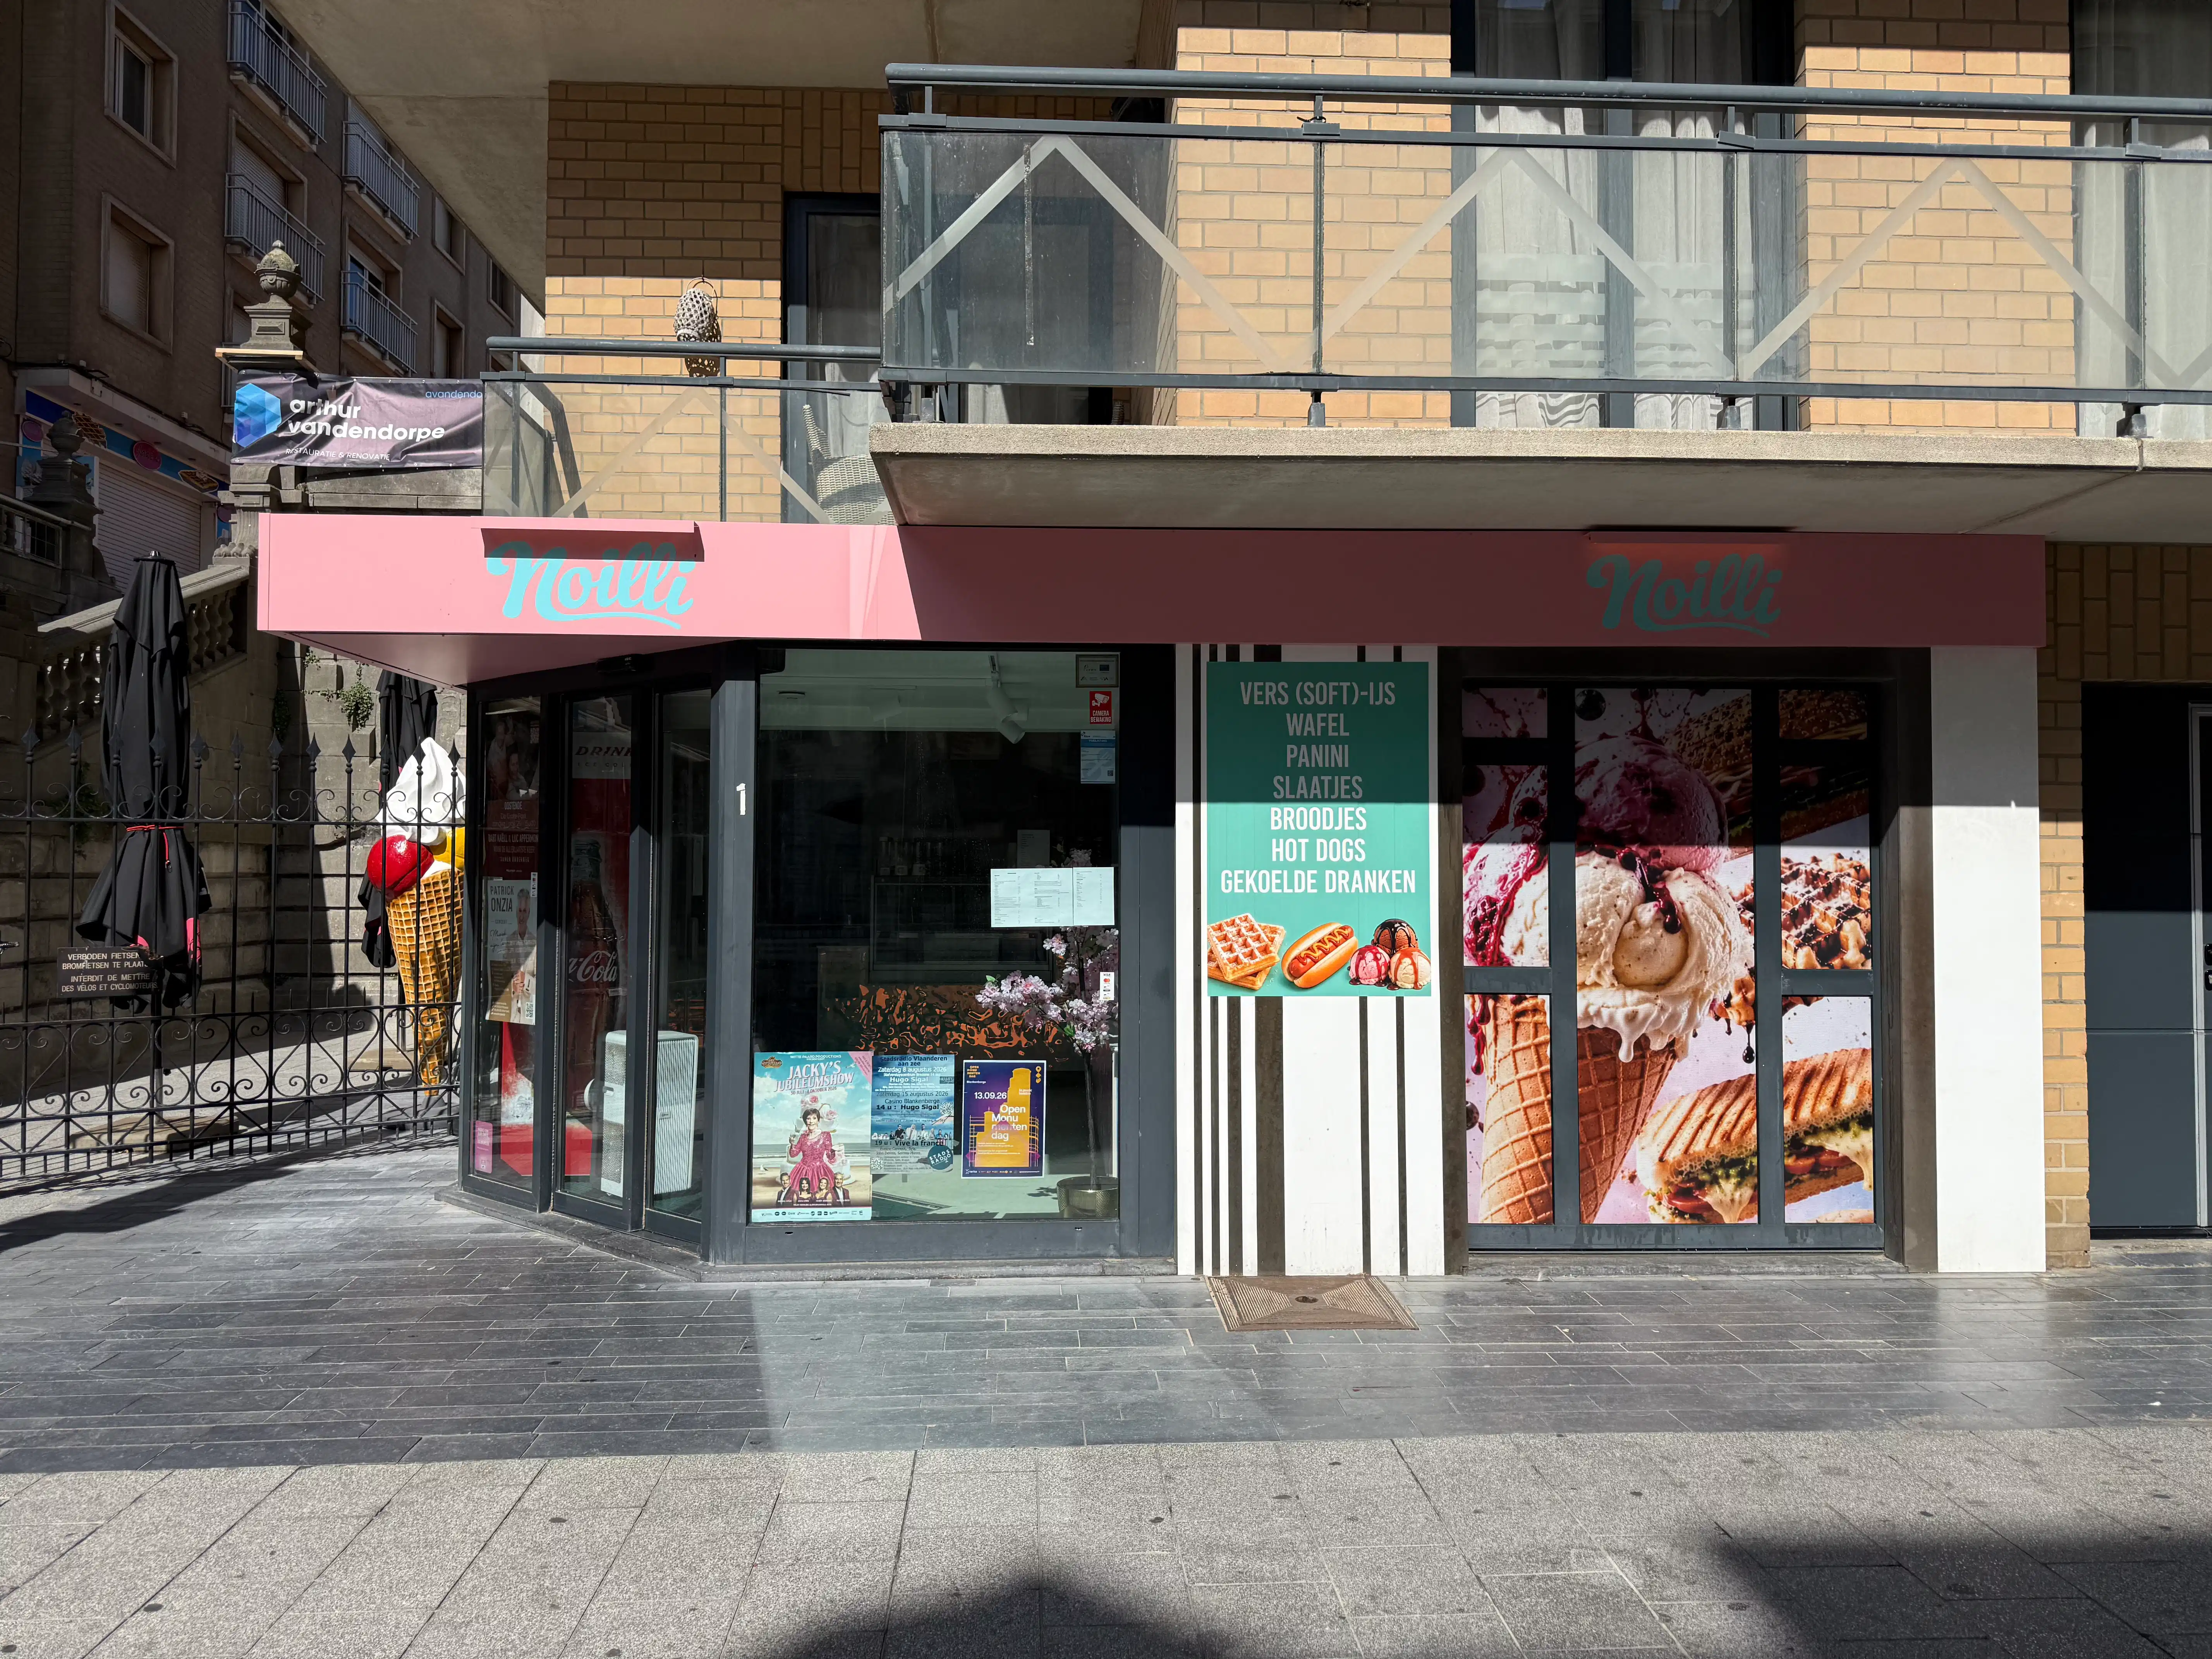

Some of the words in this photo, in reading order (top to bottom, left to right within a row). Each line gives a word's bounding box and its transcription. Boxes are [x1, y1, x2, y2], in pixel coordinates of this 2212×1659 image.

[290, 398, 361, 419] arthur
[288, 419, 445, 442] vandendorpe
[285, 448, 336, 458] RESTAURATIE
[347, 452, 390, 460] RENOVATIE
[487, 541, 696, 630] Noilli
[1586, 553, 1783, 638] Noilli
[1240, 682, 1290, 705] VERS
[1296, 682, 1396, 705] (SOFT)-IJS
[1286, 713, 1350, 736] WAFEL
[1286, 744, 1349, 768] PANINI
[1273, 776, 1363, 799] SLAATJES
[736, 783, 746, 815] 1
[1271, 807, 1367, 830] BROODJES
[1272, 838, 1309, 862] HOT
[1317, 838, 1366, 862] DOGS
[490, 886, 514, 895] PATRICK
[1221, 870, 1317, 893] GEKOELDE
[1325, 870, 1415, 893] DRANKEN
[491, 898, 513, 912] ONZIA
[77, 983, 96, 991] VÉLOS
[787, 1060, 842, 1080] JACKY'S
[773, 1072, 854, 1092] JUBILEUMSHOW
[992, 1113, 1018, 1122] Monu
[1000, 1104, 1026, 1115] Open
[991, 1131, 1009, 1141] dag
[929, 1149, 950, 1161] STADS
